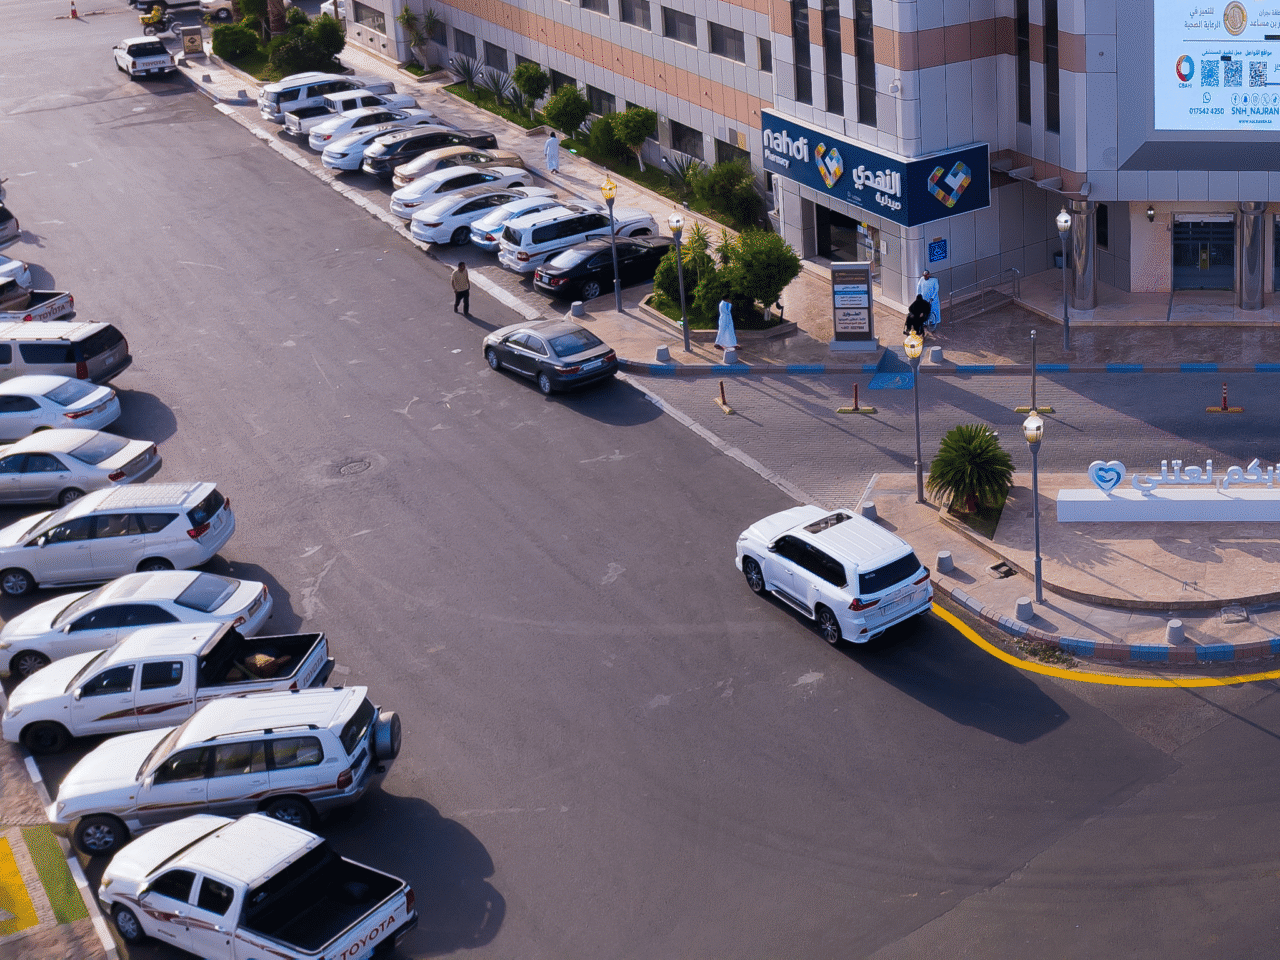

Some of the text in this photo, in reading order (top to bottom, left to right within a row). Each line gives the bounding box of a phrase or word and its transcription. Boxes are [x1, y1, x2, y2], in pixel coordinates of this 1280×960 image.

[1231, 106, 1280, 117] SNH_NAJRAN
[763, 128, 810, 163] nahdi
[852, 165, 902, 198] النهدي
[875, 192, 902, 211] صيدلية
[38, 304, 66, 321] TOYOTA
[340, 914, 396, 960] TOYOTA
